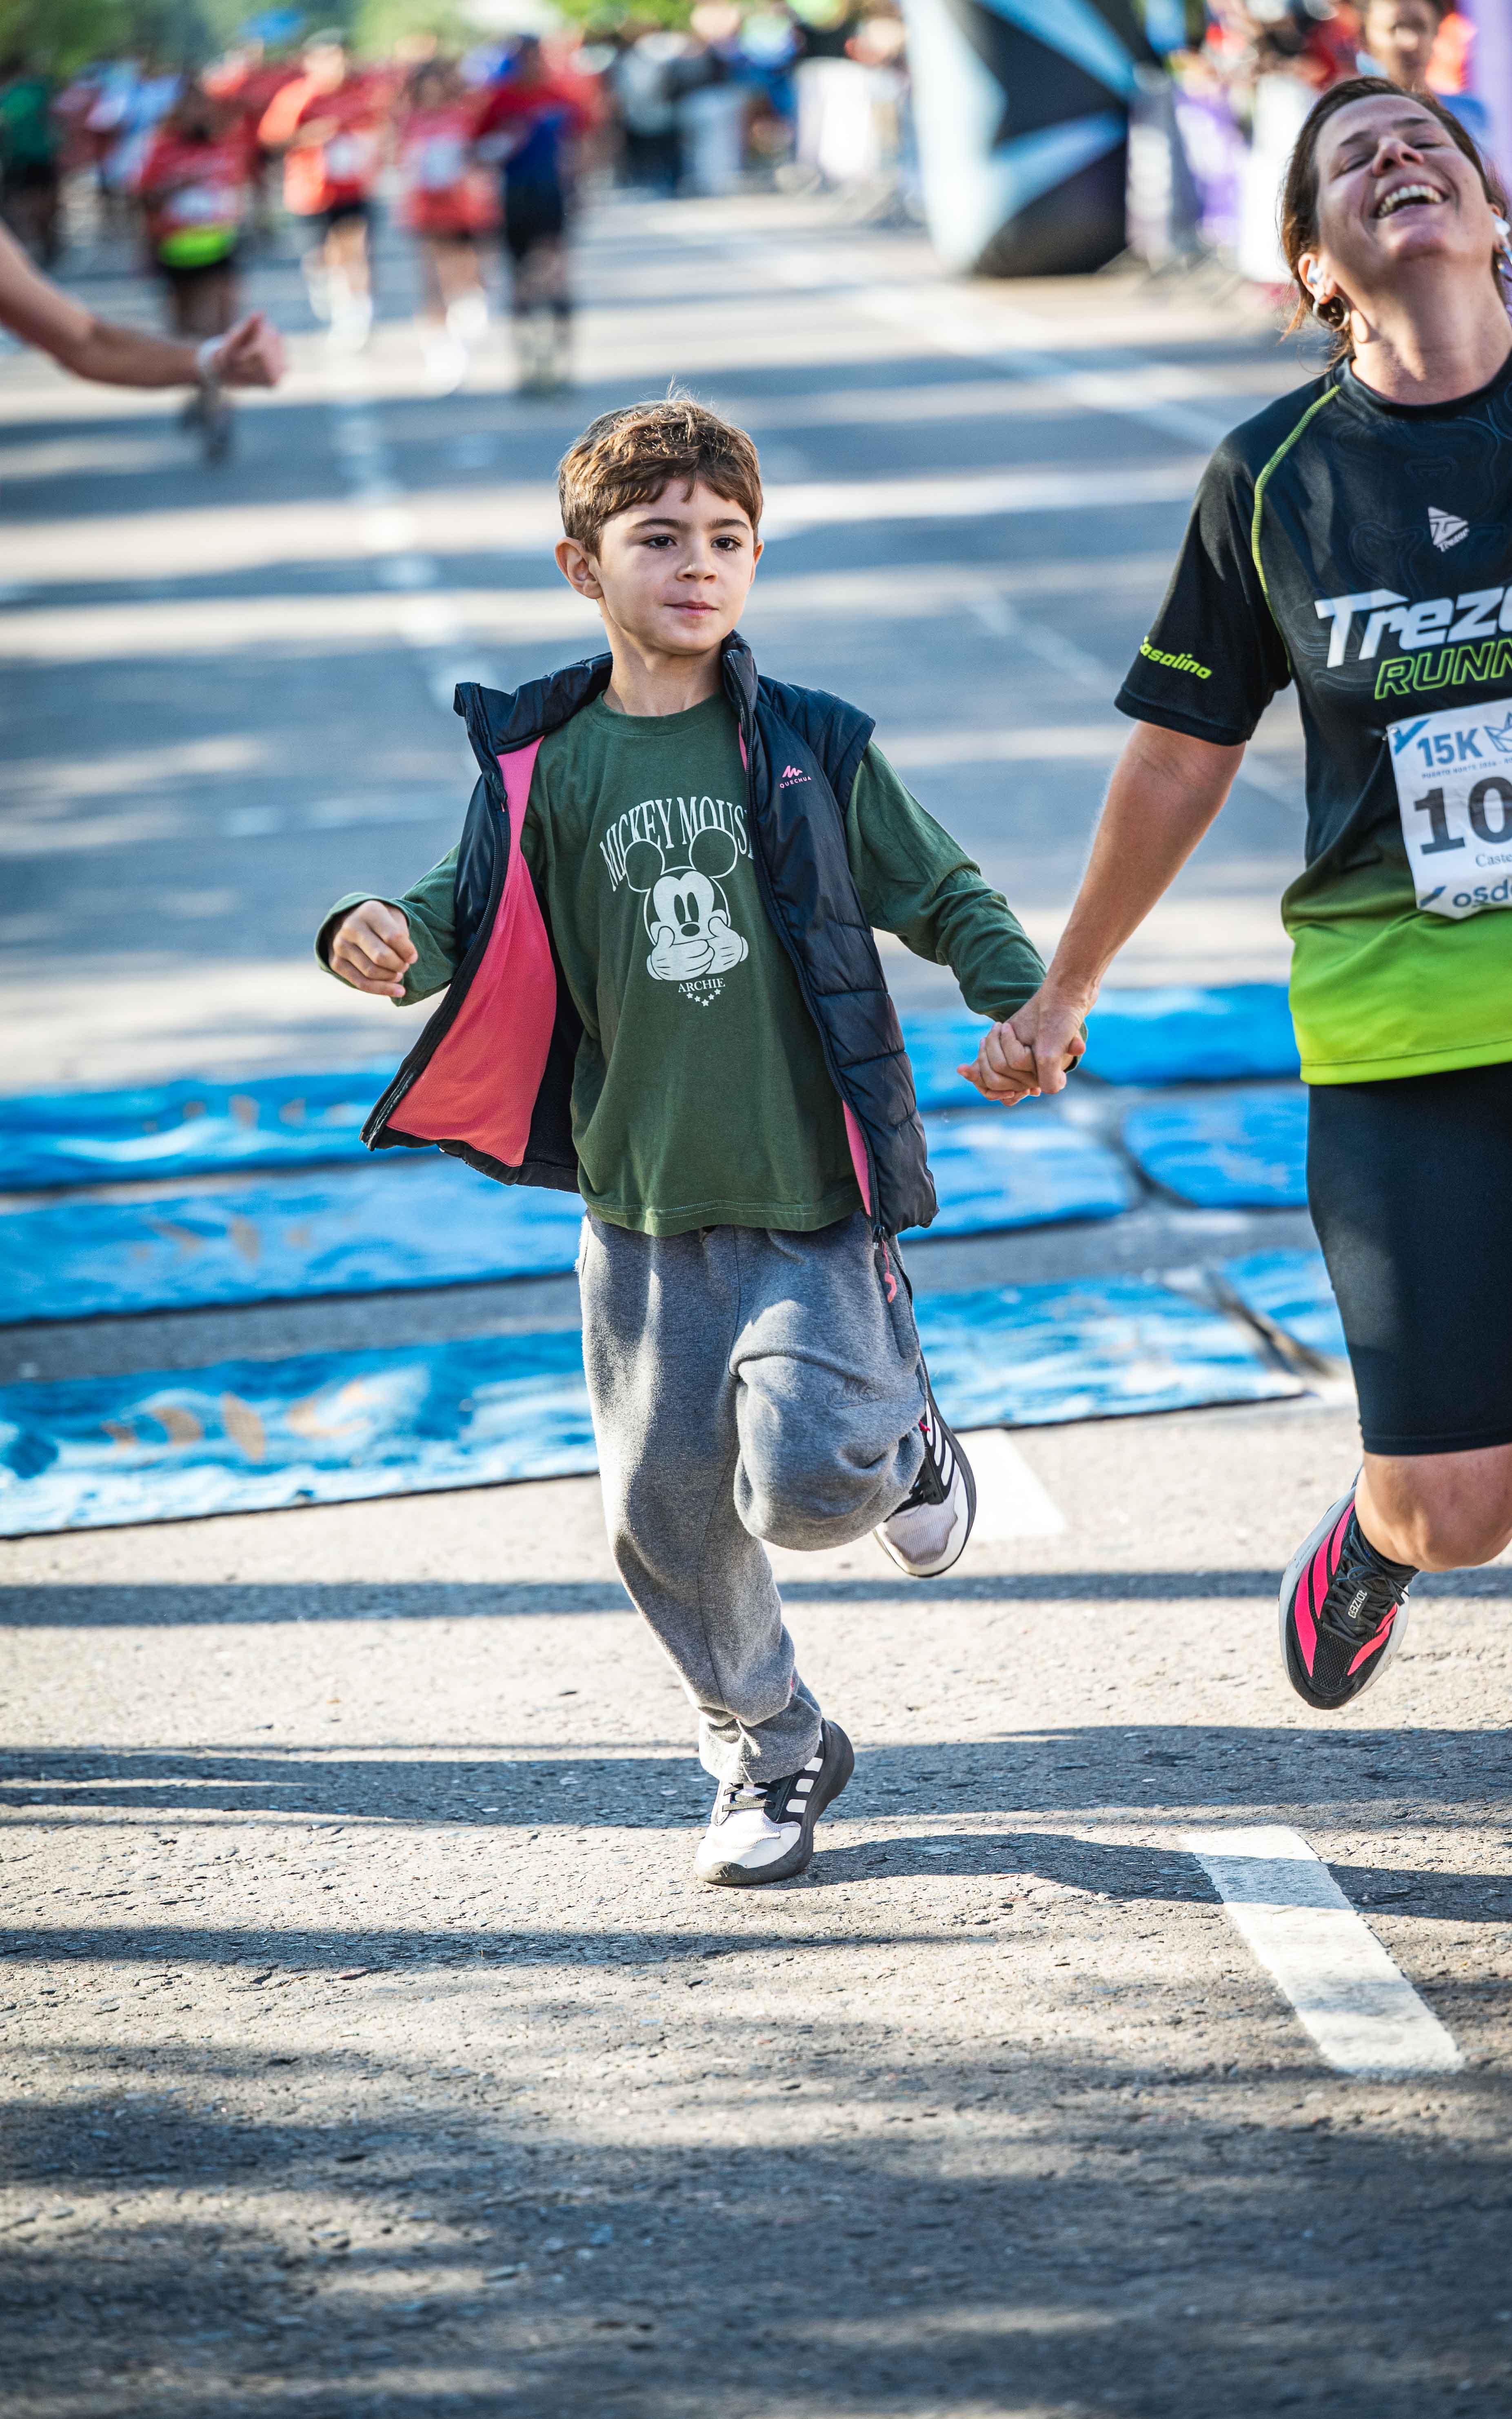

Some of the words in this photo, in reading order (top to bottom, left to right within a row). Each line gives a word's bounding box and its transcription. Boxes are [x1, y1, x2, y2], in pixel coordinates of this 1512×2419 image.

[1314, 586, 1512, 668] Trez
[1417, 728, 1483, 767] 15K
[779, 776, 811, 789] QUECHUA
[1414, 777, 1512, 855] 10
[599, 798, 674, 891] MICKEY
[677, 796, 754, 860] MOUS
[1452, 878, 1512, 907] osd
[678, 978, 726, 993] ARCHIE
